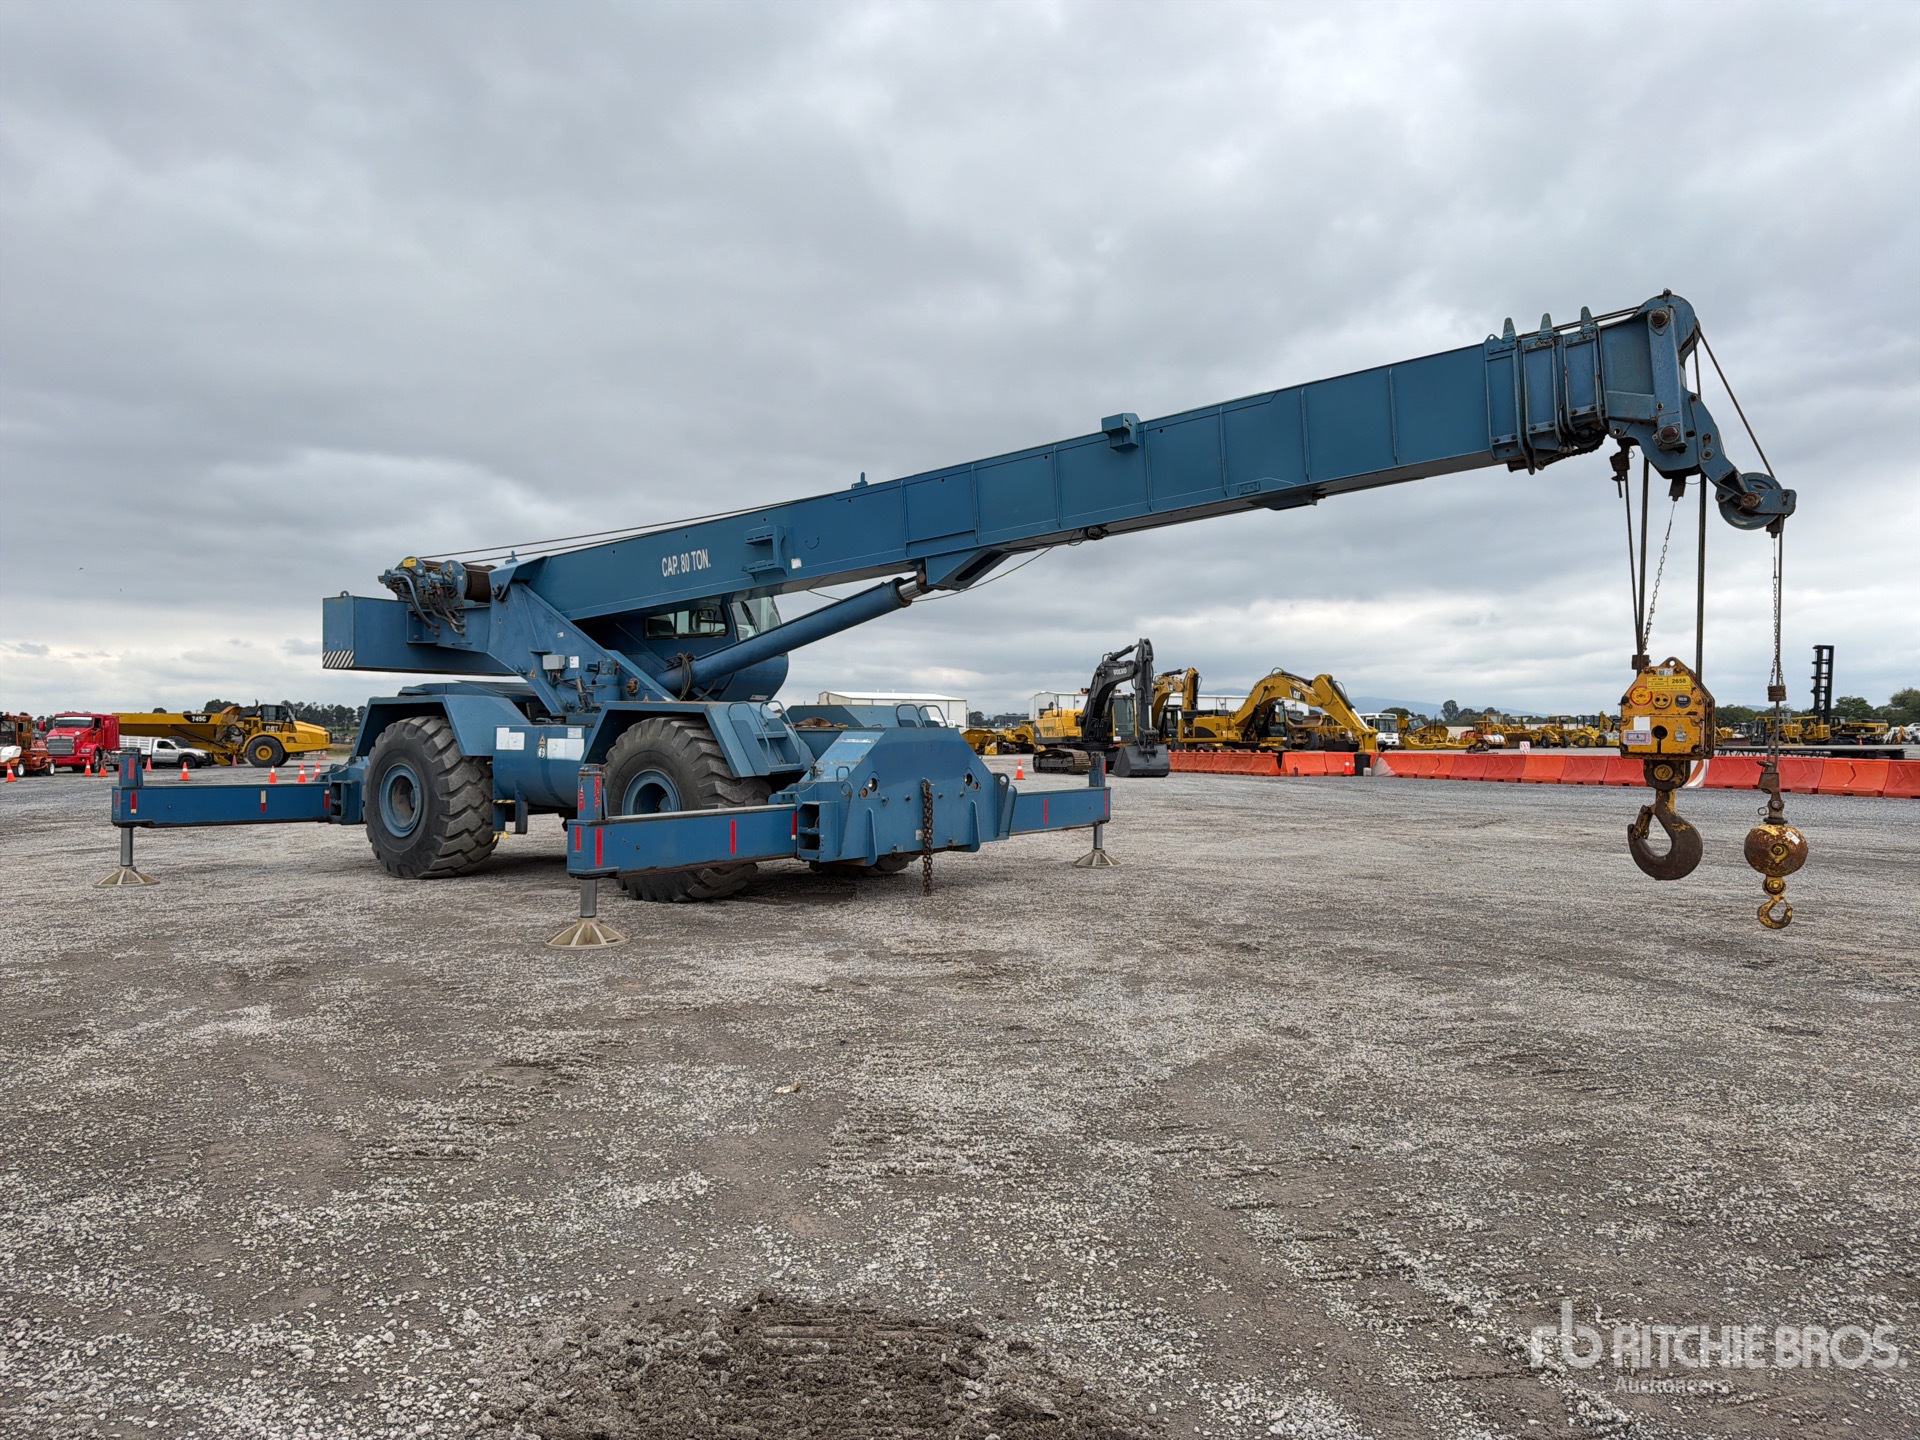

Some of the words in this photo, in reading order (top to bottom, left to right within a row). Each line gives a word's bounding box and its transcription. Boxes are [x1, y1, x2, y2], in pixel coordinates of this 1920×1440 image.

[661, 555, 680, 577] CAP.
[680, 552, 690, 573] 80
[691, 548, 711, 571] TON.
[1112, 667, 1128, 676] VOLVO
[1293, 690, 1301, 699] CAT
[265, 725, 279, 733] CAT
